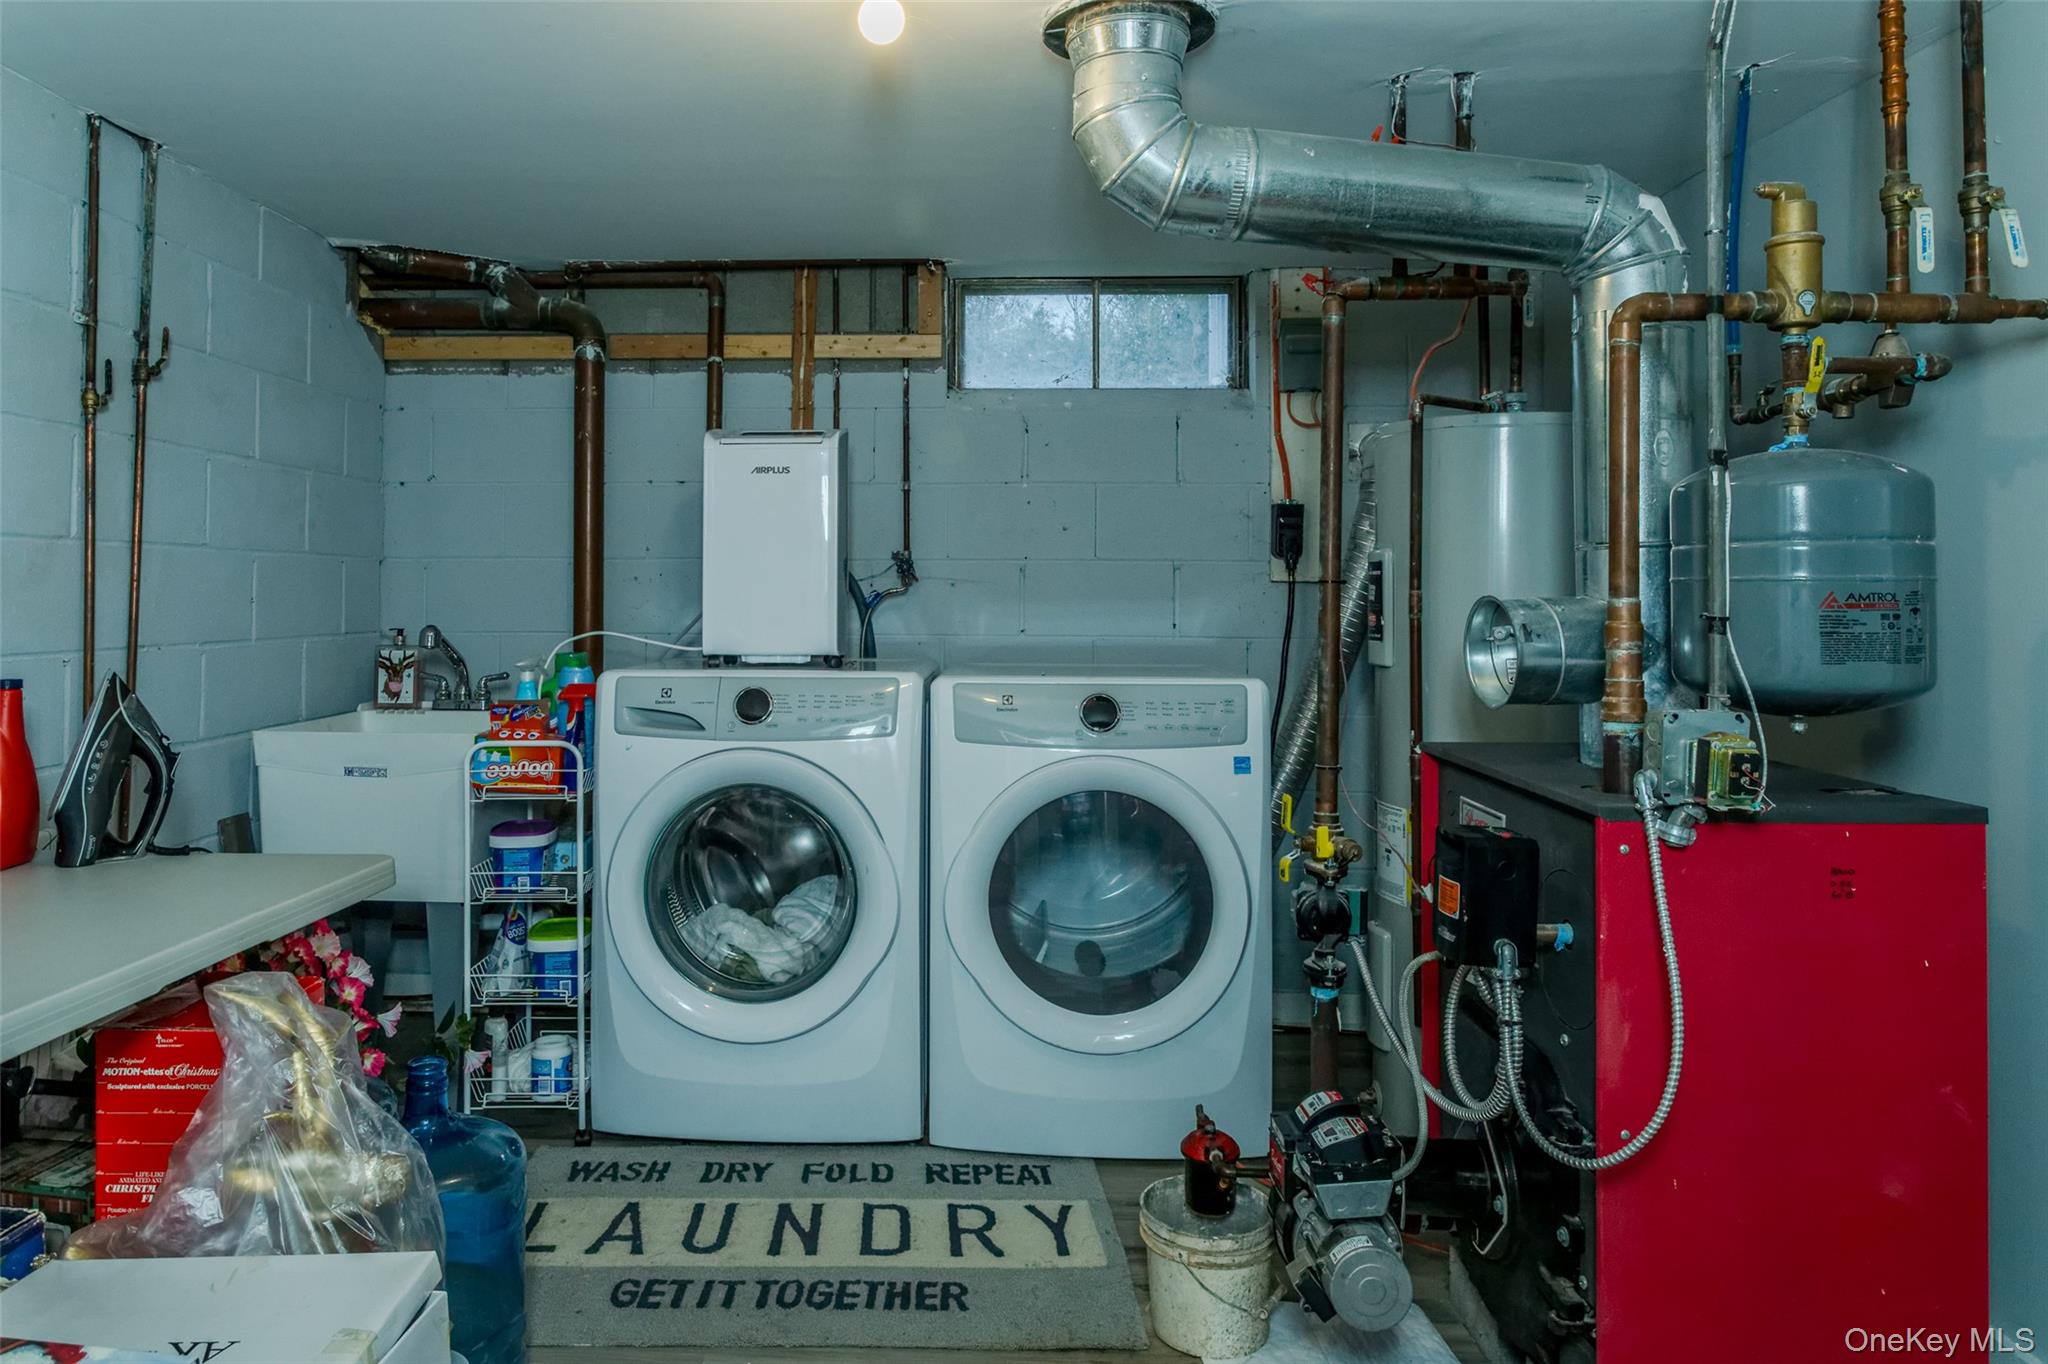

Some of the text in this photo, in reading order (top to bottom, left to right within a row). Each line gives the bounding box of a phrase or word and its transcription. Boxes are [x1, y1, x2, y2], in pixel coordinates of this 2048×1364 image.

[750, 465, 791, 474] AIRPLUS
[1844, 592, 1900, 602] AMTROL
[119, 1057, 146, 1065] Original
[102, 1067, 163, 1076] MOTION-ettes
[173, 1063, 220, 1078] Christmas
[567, 1160, 1053, 1186] WASH DRY FOLD REPEAT
[525, 1201, 1074, 1258] LAUNDRY
[608, 1278, 970, 1312] GET IT TOGETHER
